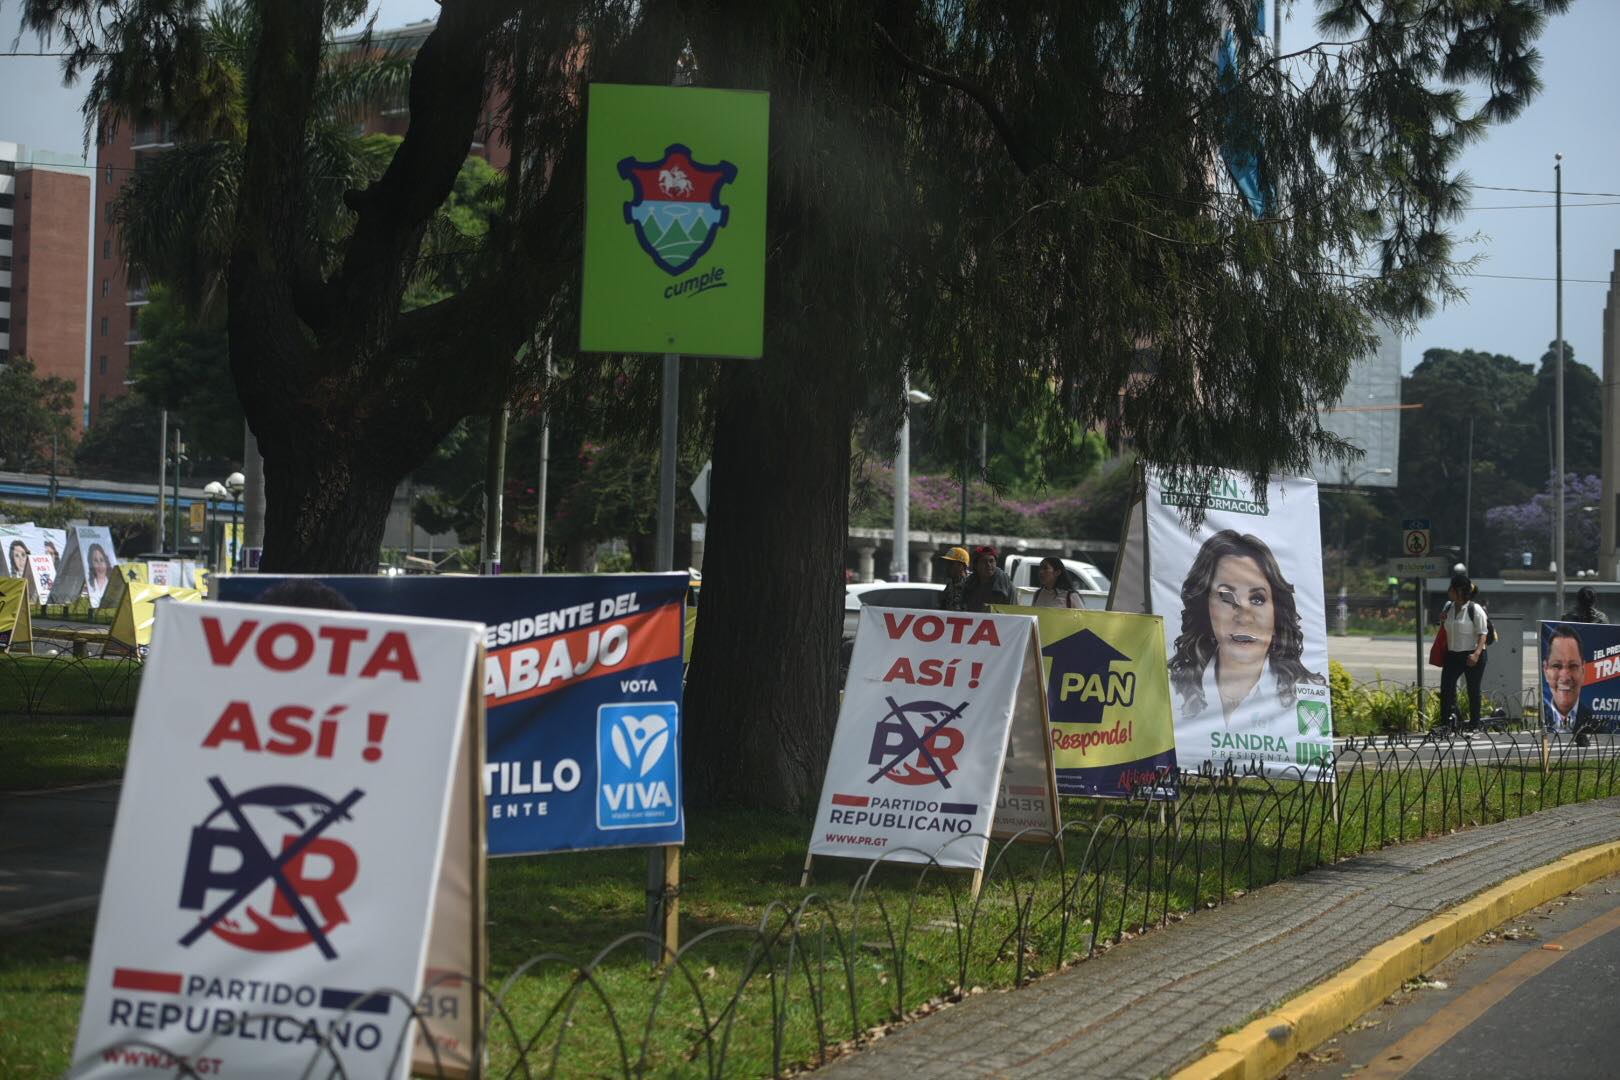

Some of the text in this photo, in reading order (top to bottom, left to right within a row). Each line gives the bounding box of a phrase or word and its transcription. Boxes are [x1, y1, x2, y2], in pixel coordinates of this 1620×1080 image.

[663, 267, 726, 298] cumple
[1162, 494, 1265, 514] TRANSORMACIÓN
[599, 592, 640, 620] DEL
[883, 612, 1001, 646] VOTA
[201, 616, 421, 682] VOTA
[484, 624, 629, 698] ABAJO
[620, 680, 657, 693] VOTA
[1060, 672, 1136, 707] PAN
[1051, 720, 1132, 756] Responde!
[1210, 731, 1288, 753] SANDRA
[1211, 750, 1290, 762] PRESIDENTA
[603, 781, 672, 810] VIVA
[871, 797, 938, 813] PARTIDO
[492, 802, 548, 818] ENTE
[830, 809, 972, 835] REPUBLICANO
[825, 833, 888, 847] WWW.PR.GT
[187, 976, 321, 1008] PARTIDO
[109, 999, 382, 1051] REPUBLICANO
